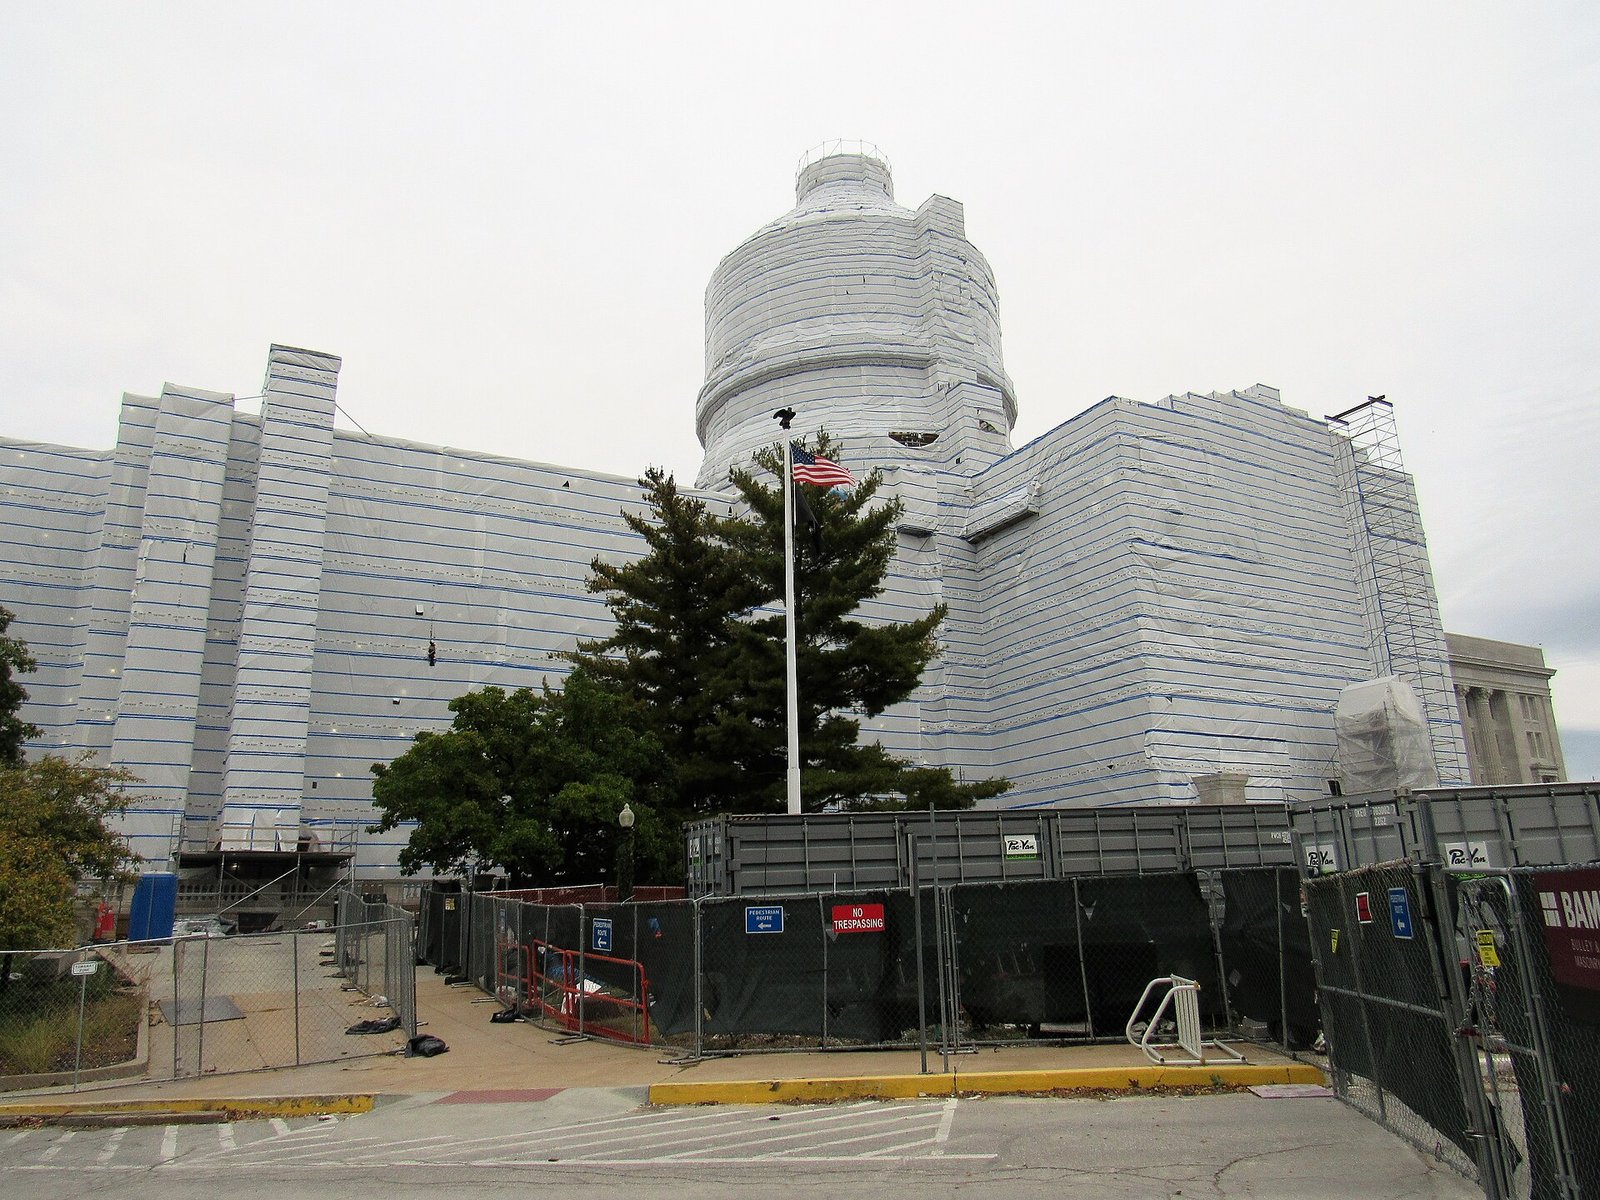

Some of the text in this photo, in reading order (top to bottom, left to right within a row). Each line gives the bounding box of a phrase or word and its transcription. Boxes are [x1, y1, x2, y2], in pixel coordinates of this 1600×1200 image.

[852, 907, 864, 917] NO
[1560, 890, 1600, 929] BAM
[833, 918, 884, 930] TRESPASSING
